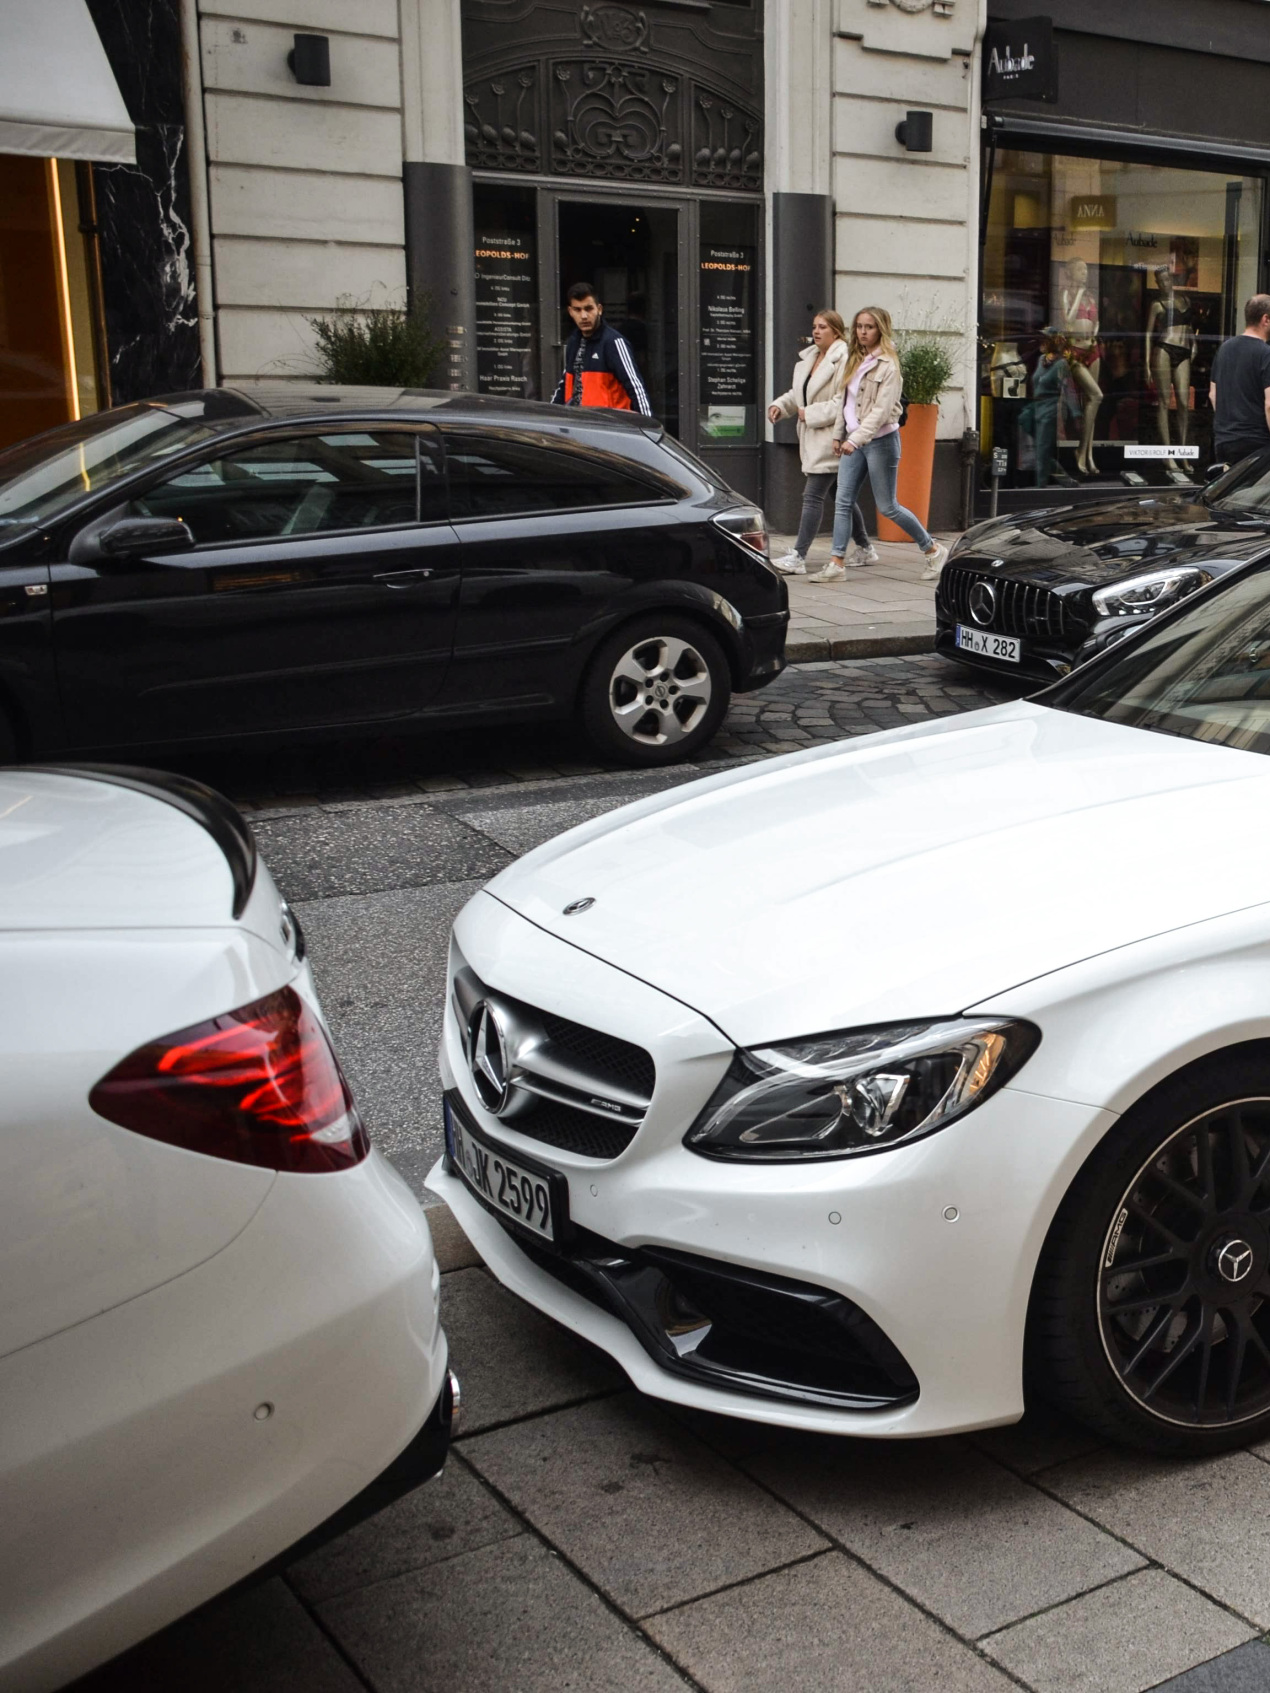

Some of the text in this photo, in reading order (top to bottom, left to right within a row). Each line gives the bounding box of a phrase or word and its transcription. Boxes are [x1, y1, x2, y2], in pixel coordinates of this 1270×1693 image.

[988, 43, 1035, 77] Aubade
[482, 237, 516, 246] Poststraße
[1125, 231, 1158, 249] Aubade
[475, 250, 529, 260] EOPOLDS-HOF
[710, 250, 739, 259] Poststraße
[701, 262, 751, 272] LEOPOLDS-HOF
[1177, 447, 1195, 456] Aubade
[961, 629, 1016, 659] HH X 282
[471, 1140, 494, 1198] JK
[494, 1159, 550, 1231] 2599
